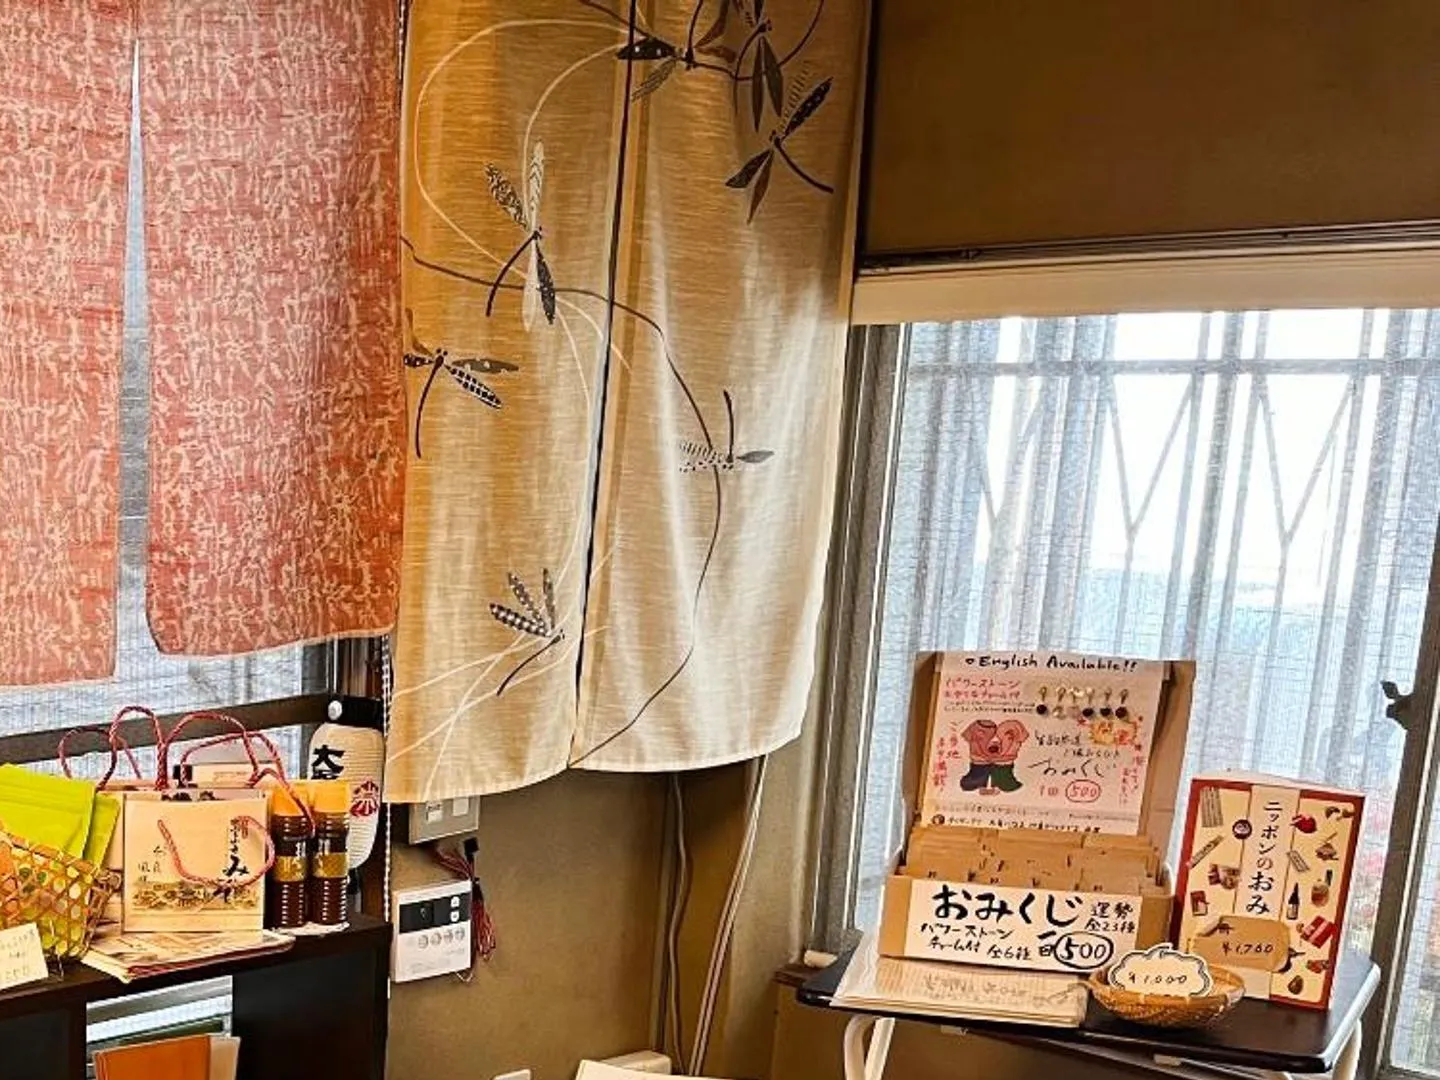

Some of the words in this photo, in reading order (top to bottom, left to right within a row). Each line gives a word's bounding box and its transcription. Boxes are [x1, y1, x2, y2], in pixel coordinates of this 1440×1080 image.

[979, 654, 1038, 671] English
[1046, 655, 1137, 673] Available!!
[932, 884, 1083, 928] おみくじ
[1091, 901, 1134, 920] 運勢
[920, 922, 1014, 940] パワーストーン
[1059, 936, 1107, 961] 500
